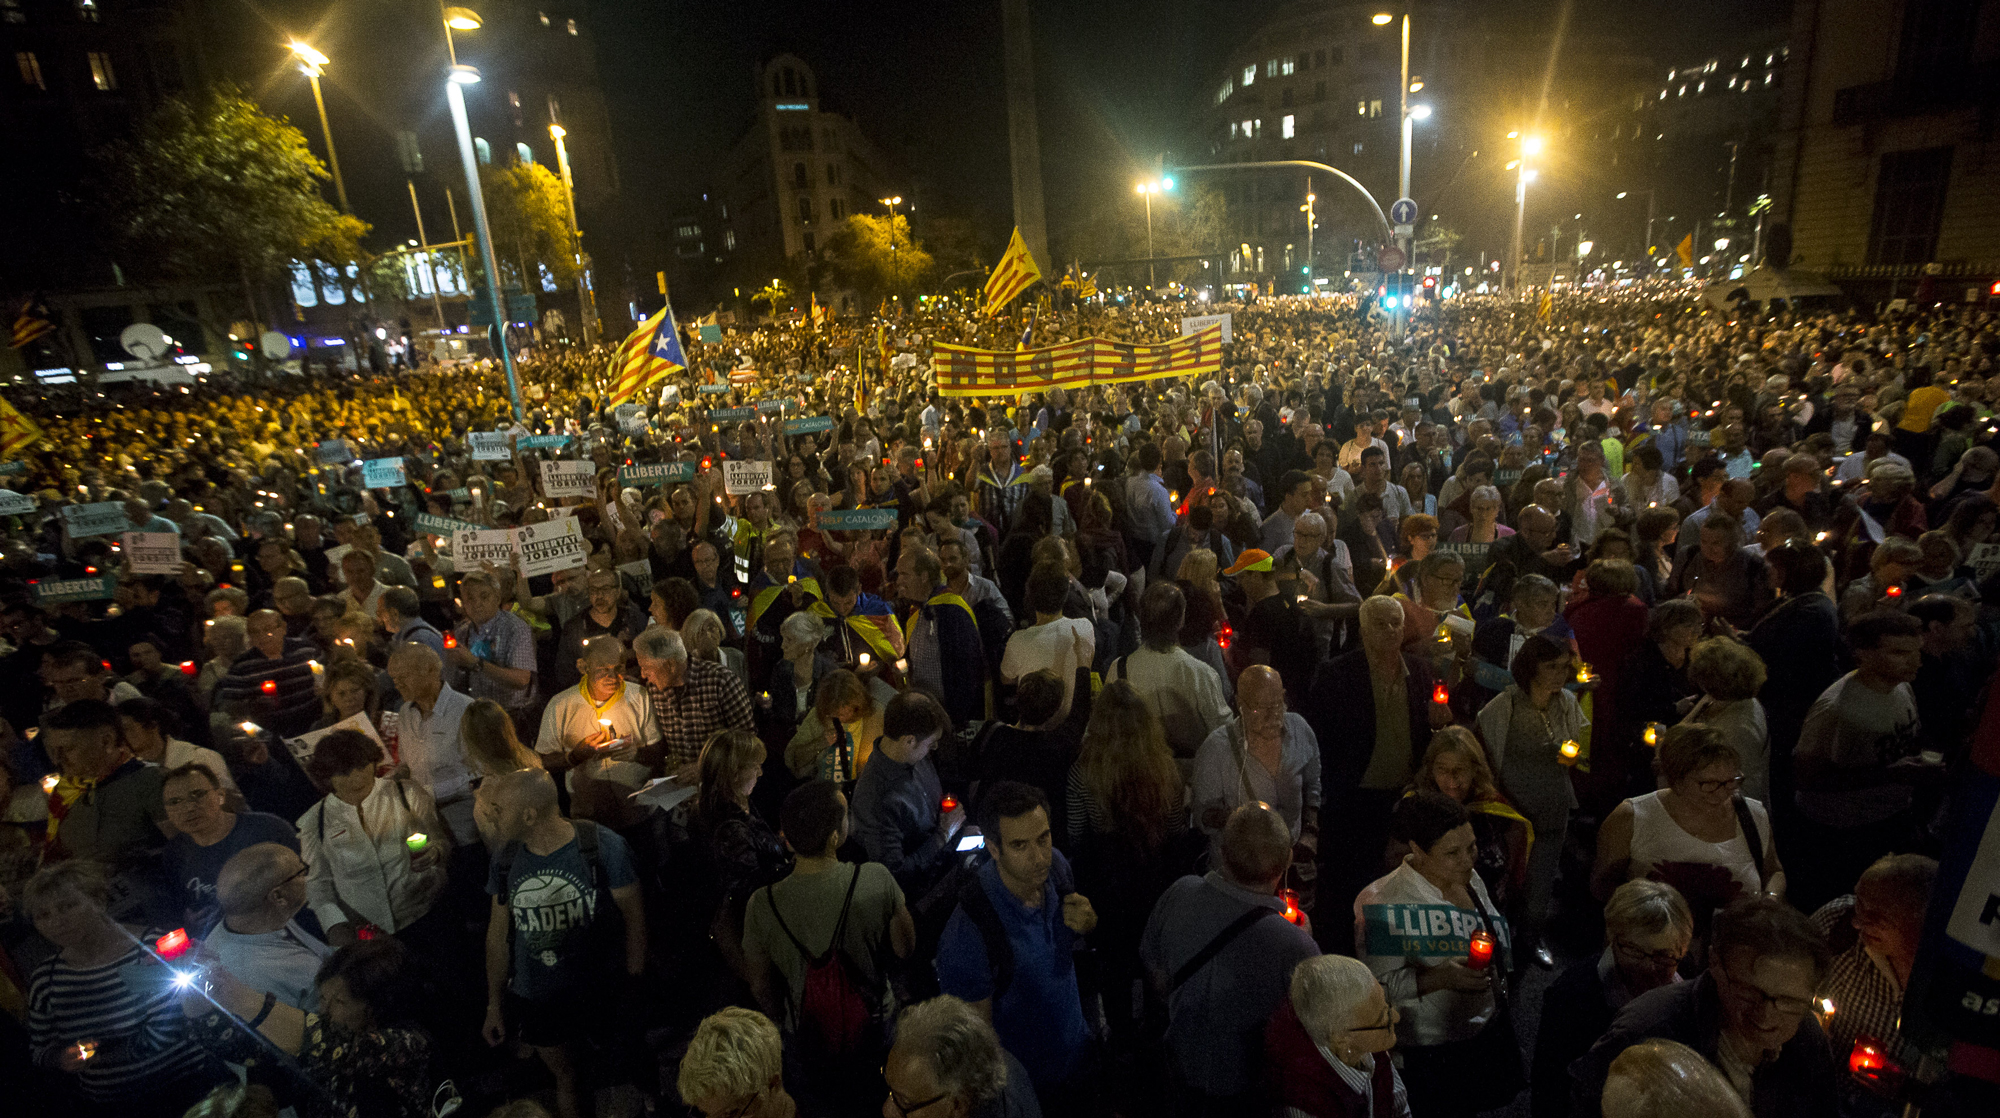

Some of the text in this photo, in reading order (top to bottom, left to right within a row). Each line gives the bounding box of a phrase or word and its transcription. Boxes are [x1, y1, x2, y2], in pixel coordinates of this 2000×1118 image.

[623, 463, 684, 480] LLIBERTAT
[730, 472, 769, 480] LLIBERTAT
[730, 478, 768, 486] JORDIS!
[845, 514, 893, 524] CATALONIA
[461, 543, 513, 554] LLIBERTAT
[521, 534, 578, 556] LLIBERTAT
[526, 543, 579, 562] JORDIS!
[37, 579, 105, 596] LLIBERTAT
[1402, 940, 1421, 951] US
